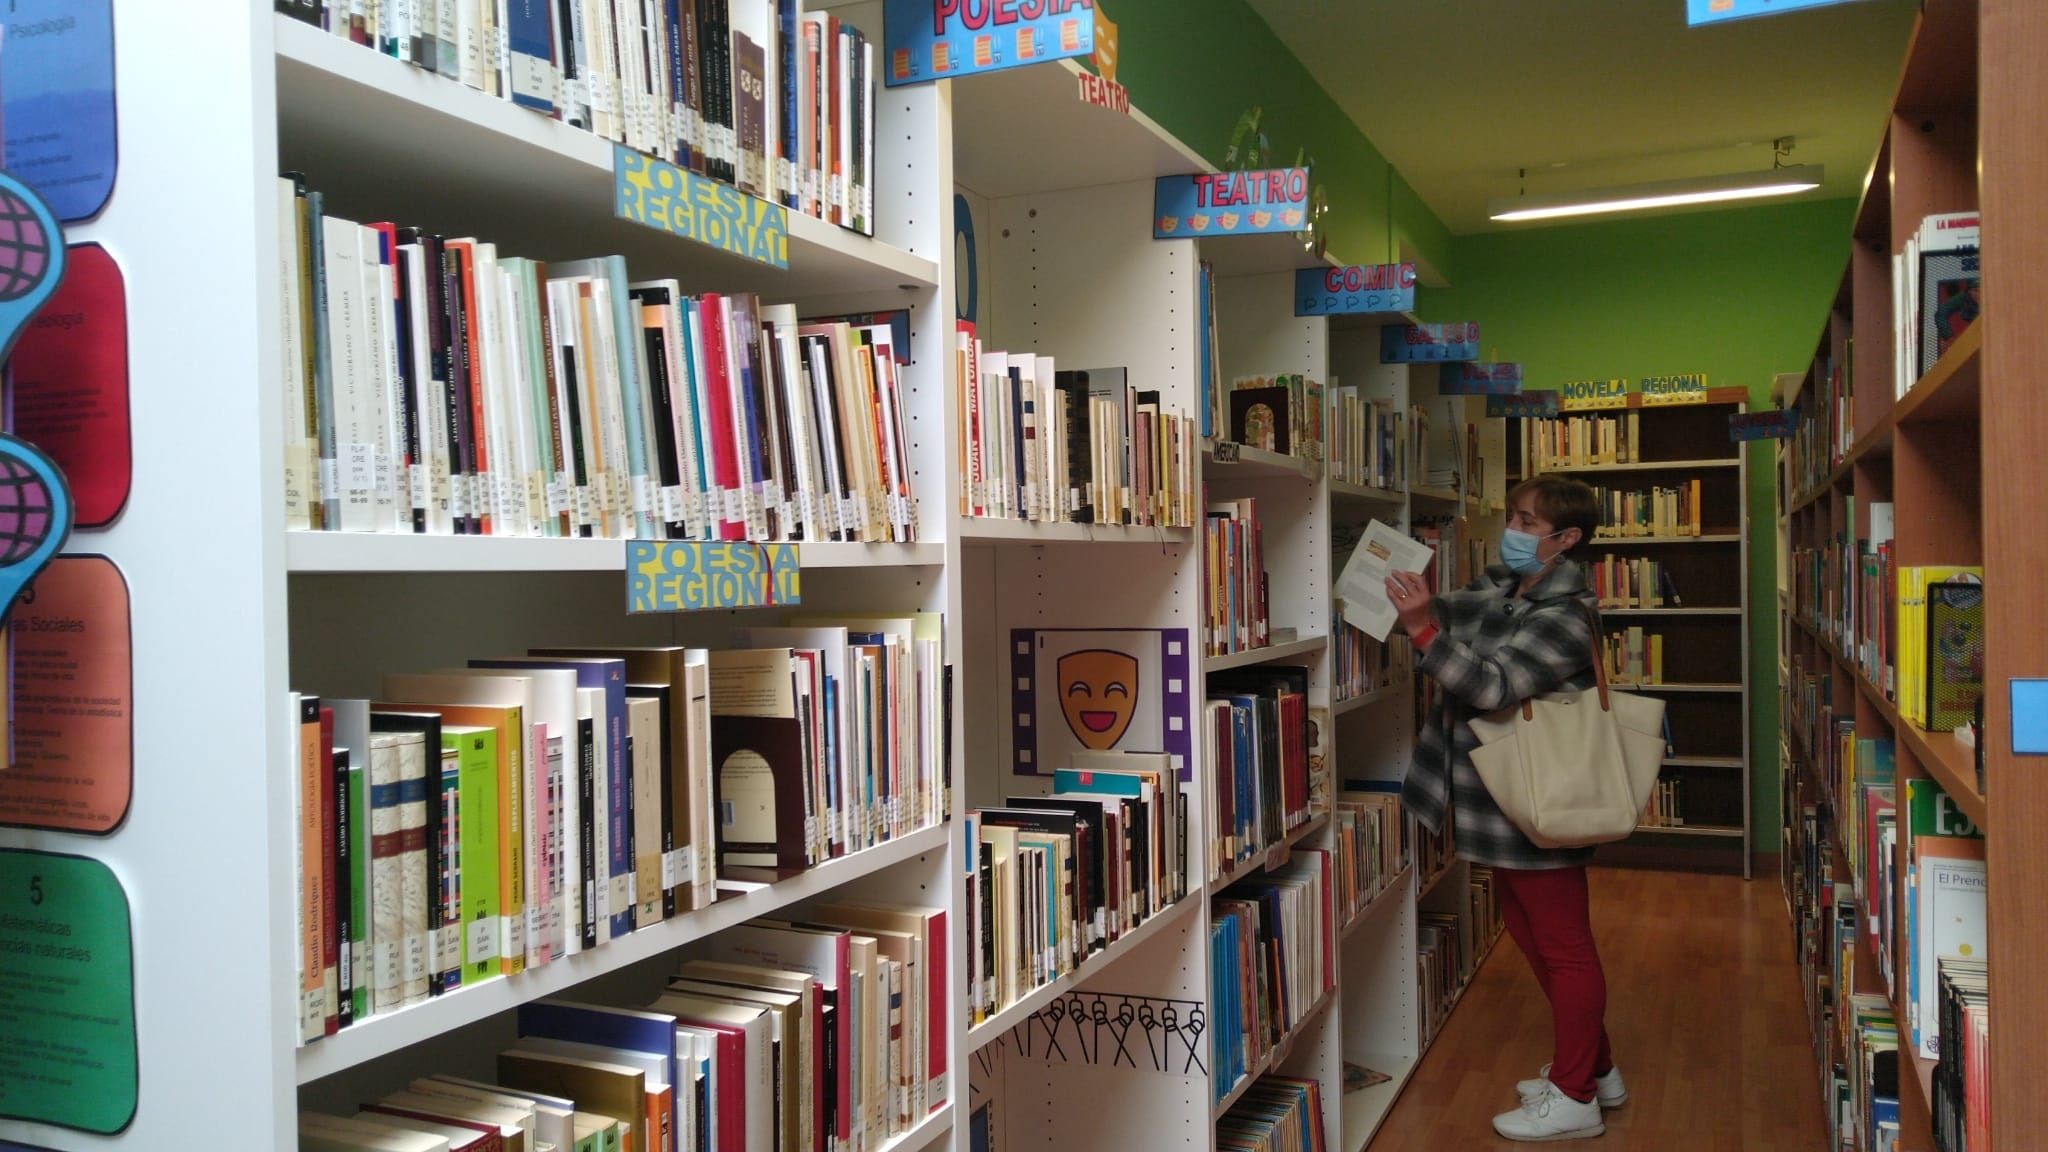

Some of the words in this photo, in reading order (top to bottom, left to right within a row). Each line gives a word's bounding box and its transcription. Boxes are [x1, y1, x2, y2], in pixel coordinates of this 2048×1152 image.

[933, 0, 1092, 36] POES
[1079, 72, 1130, 115] TEATRO
[615, 146, 787, 235] POESIA
[1193, 168, 1308, 208] TEATRO
[615, 181, 789, 269] REGIONAL
[1325, 263, 1416, 293] COMIC
[345, 334, 355, 394] VICTORIANO
[1564, 380, 1627, 398] NOVELA
[1641, 374, 1707, 393] REGIONAL
[968, 440, 981, 482] JUAN
[627, 541, 799, 575] POESIA
[628, 573, 801, 613] REGIONAL
[31, 616, 85, 633] Sociales
[29, 874, 44, 907] 5
[1938, 873, 1949, 884] El
[35, 943, 93, 962] naturales
[310, 934, 320, 979] Claudio
